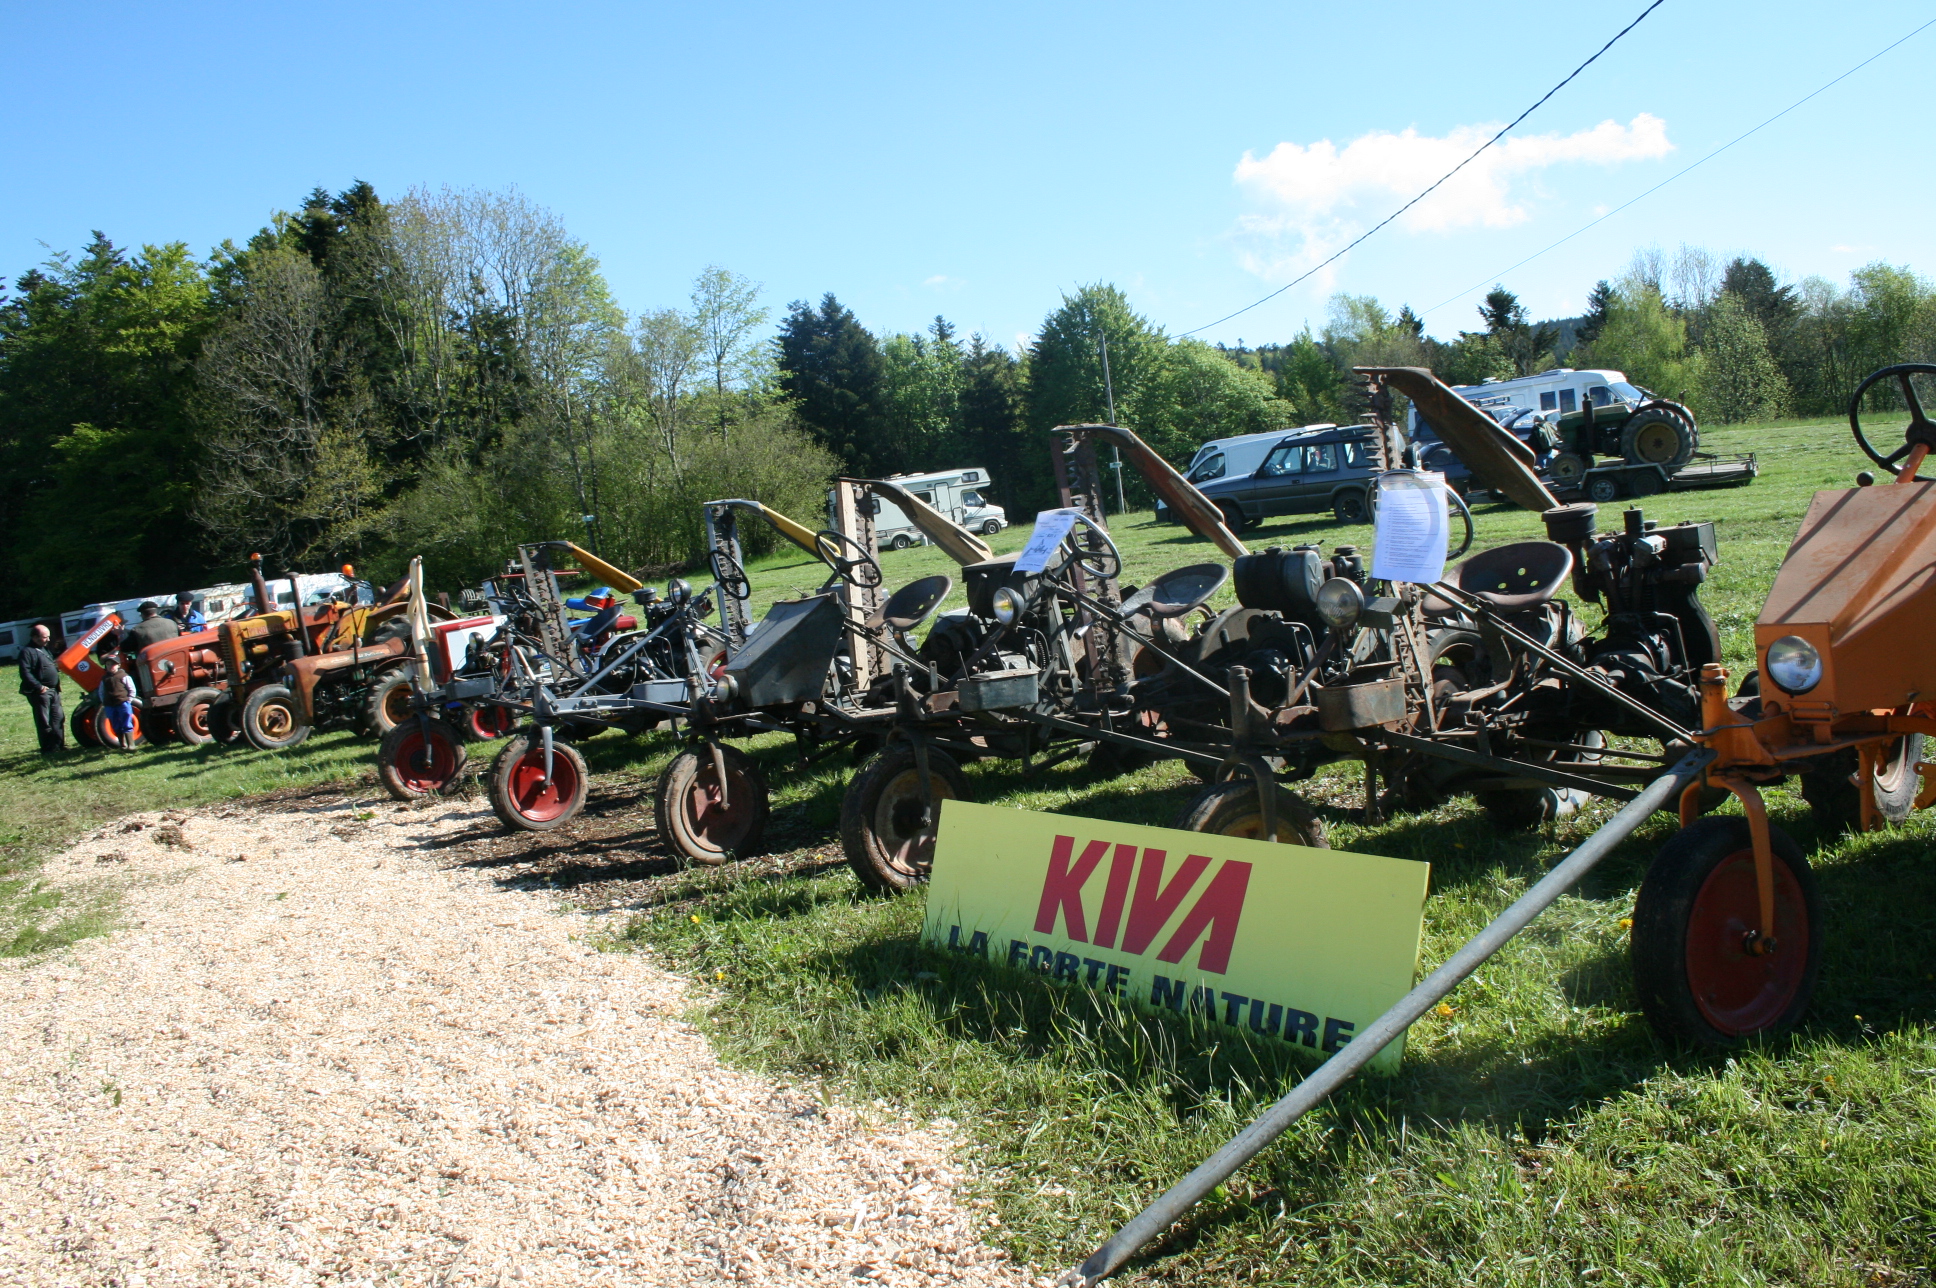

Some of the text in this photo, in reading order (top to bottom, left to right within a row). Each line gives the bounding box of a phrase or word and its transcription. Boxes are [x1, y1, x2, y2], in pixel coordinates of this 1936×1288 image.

[1033, 834, 1253, 975] KIVA
[948, 925, 1355, 1054] LA FORTE NATURE
